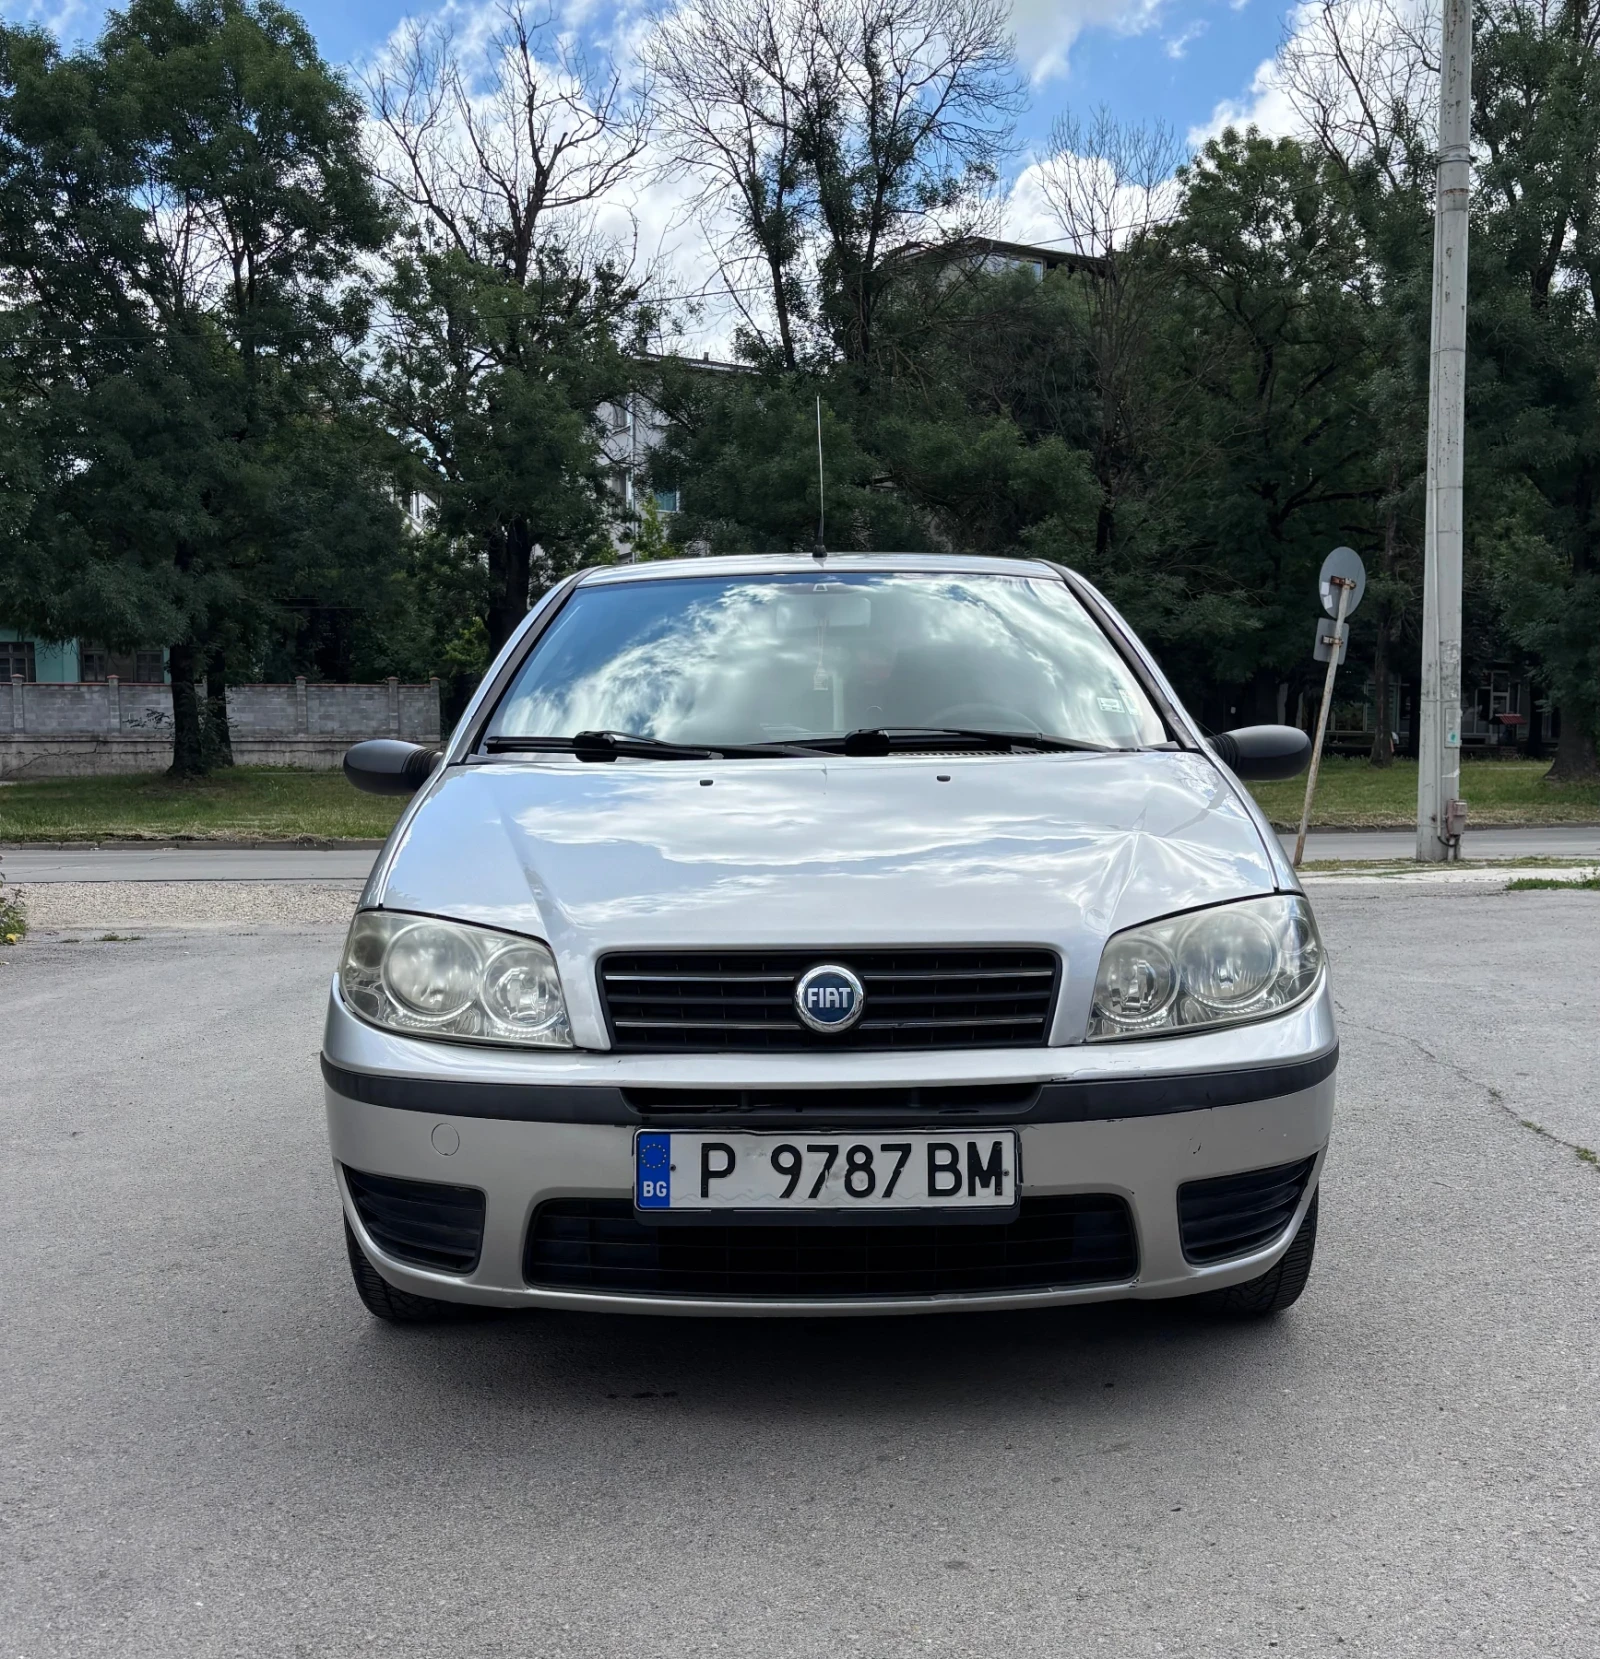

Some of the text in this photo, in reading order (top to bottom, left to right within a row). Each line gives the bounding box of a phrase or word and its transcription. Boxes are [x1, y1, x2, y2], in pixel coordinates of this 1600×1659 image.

[807, 987, 851, 1008] FIAT
[700, 1140, 1004, 1199] P 9787 BM
[642, 1180, 668, 1198] BG
